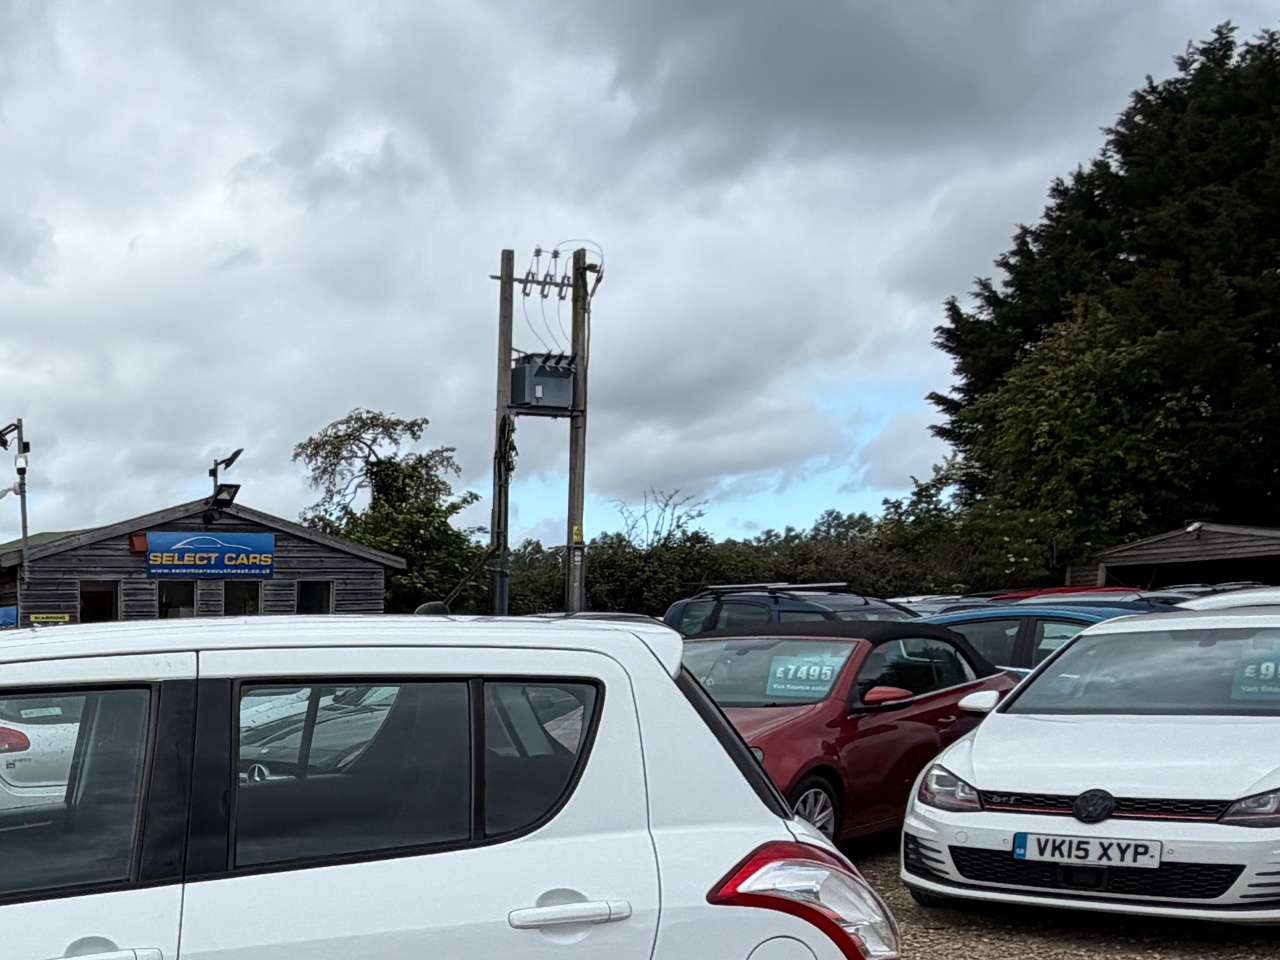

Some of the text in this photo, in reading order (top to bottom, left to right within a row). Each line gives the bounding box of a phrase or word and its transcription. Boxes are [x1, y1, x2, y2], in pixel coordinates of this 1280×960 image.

[149, 553, 273, 565] SELECT CARS
[1244, 662, 1280, 680] £9
[1036, 838, 1091, 860] VK15
[1097, 841, 1150, 864] XYP
